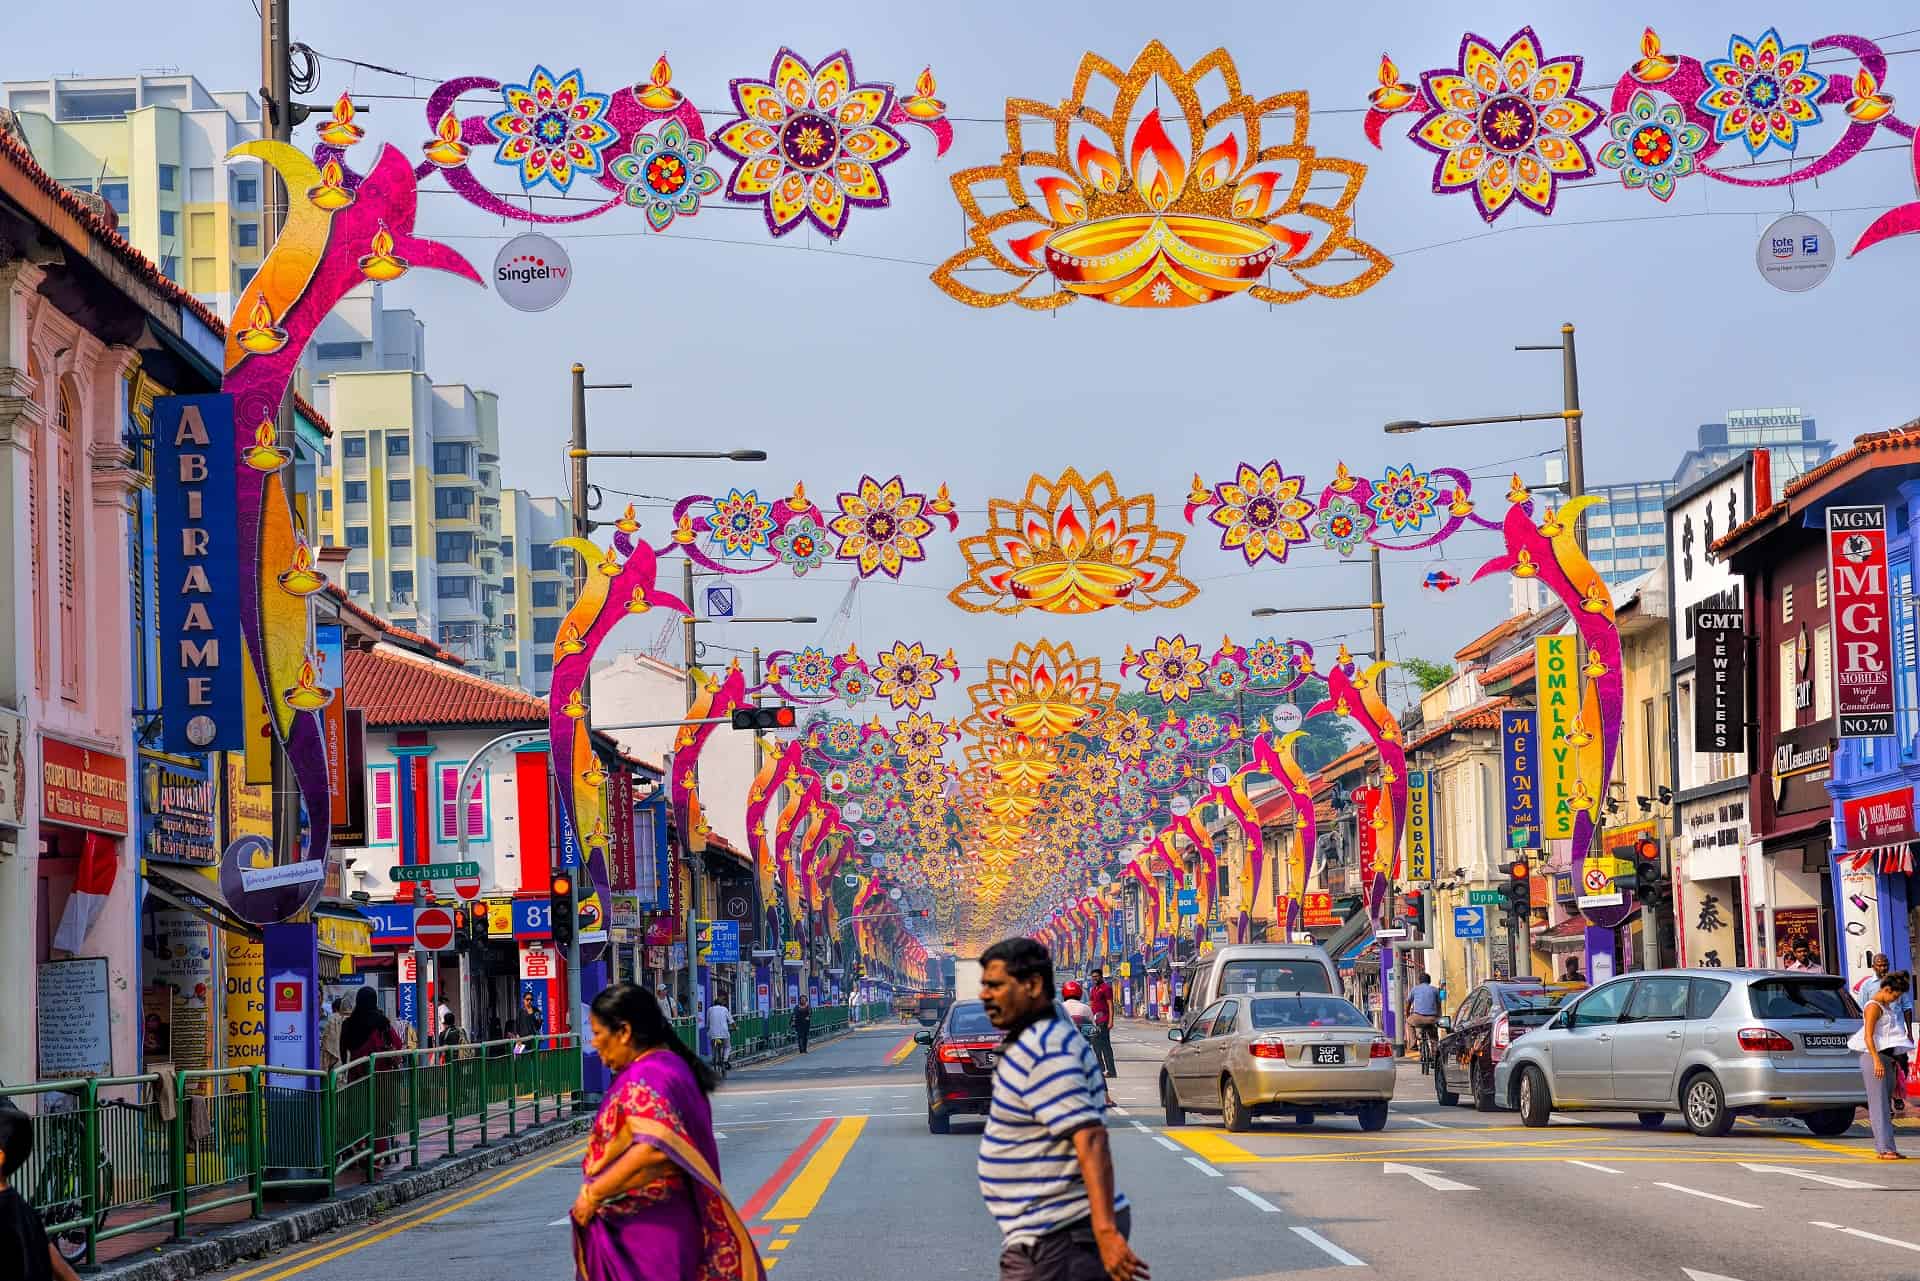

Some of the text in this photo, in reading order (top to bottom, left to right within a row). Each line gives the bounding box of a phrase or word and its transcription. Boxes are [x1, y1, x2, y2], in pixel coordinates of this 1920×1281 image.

[1772, 237, 1793, 247] tote
[1731, 415, 1800, 427] PARKROYAL
[1832, 512, 1881, 528] MGM
[174, 404, 220, 706] ABIRAAME
[1698, 613, 1743, 629] GMT
[1837, 564, 1884, 673] MGR
[1840, 671, 1888, 685] MOBILES
[1712, 631, 1729, 748] JEWELLERS
[1852, 685, 1877, 696] World
[1840, 701, 1890, 712] Connections
[1860, 694, 1869, 705] of
[1844, 718, 1888, 732] NO.70
[1548, 639, 1570, 832] KOMALA VILAS
[1777, 743, 1793, 773] GMT
[1412, 791, 1425, 878] UCO BANK
[397, 864, 472, 880] Kerbau Rd
[1457, 927, 1482, 935] ONE WAY
[227, 977, 251, 994] Old
[247, 1000, 264, 1012] Fo
[229, 1021, 265, 1036] $CA
[227, 1045, 265, 1057] EXCHA
[1319, 1046, 1337, 1055] SGP
[1317, 1054, 1340, 1064] 412C
